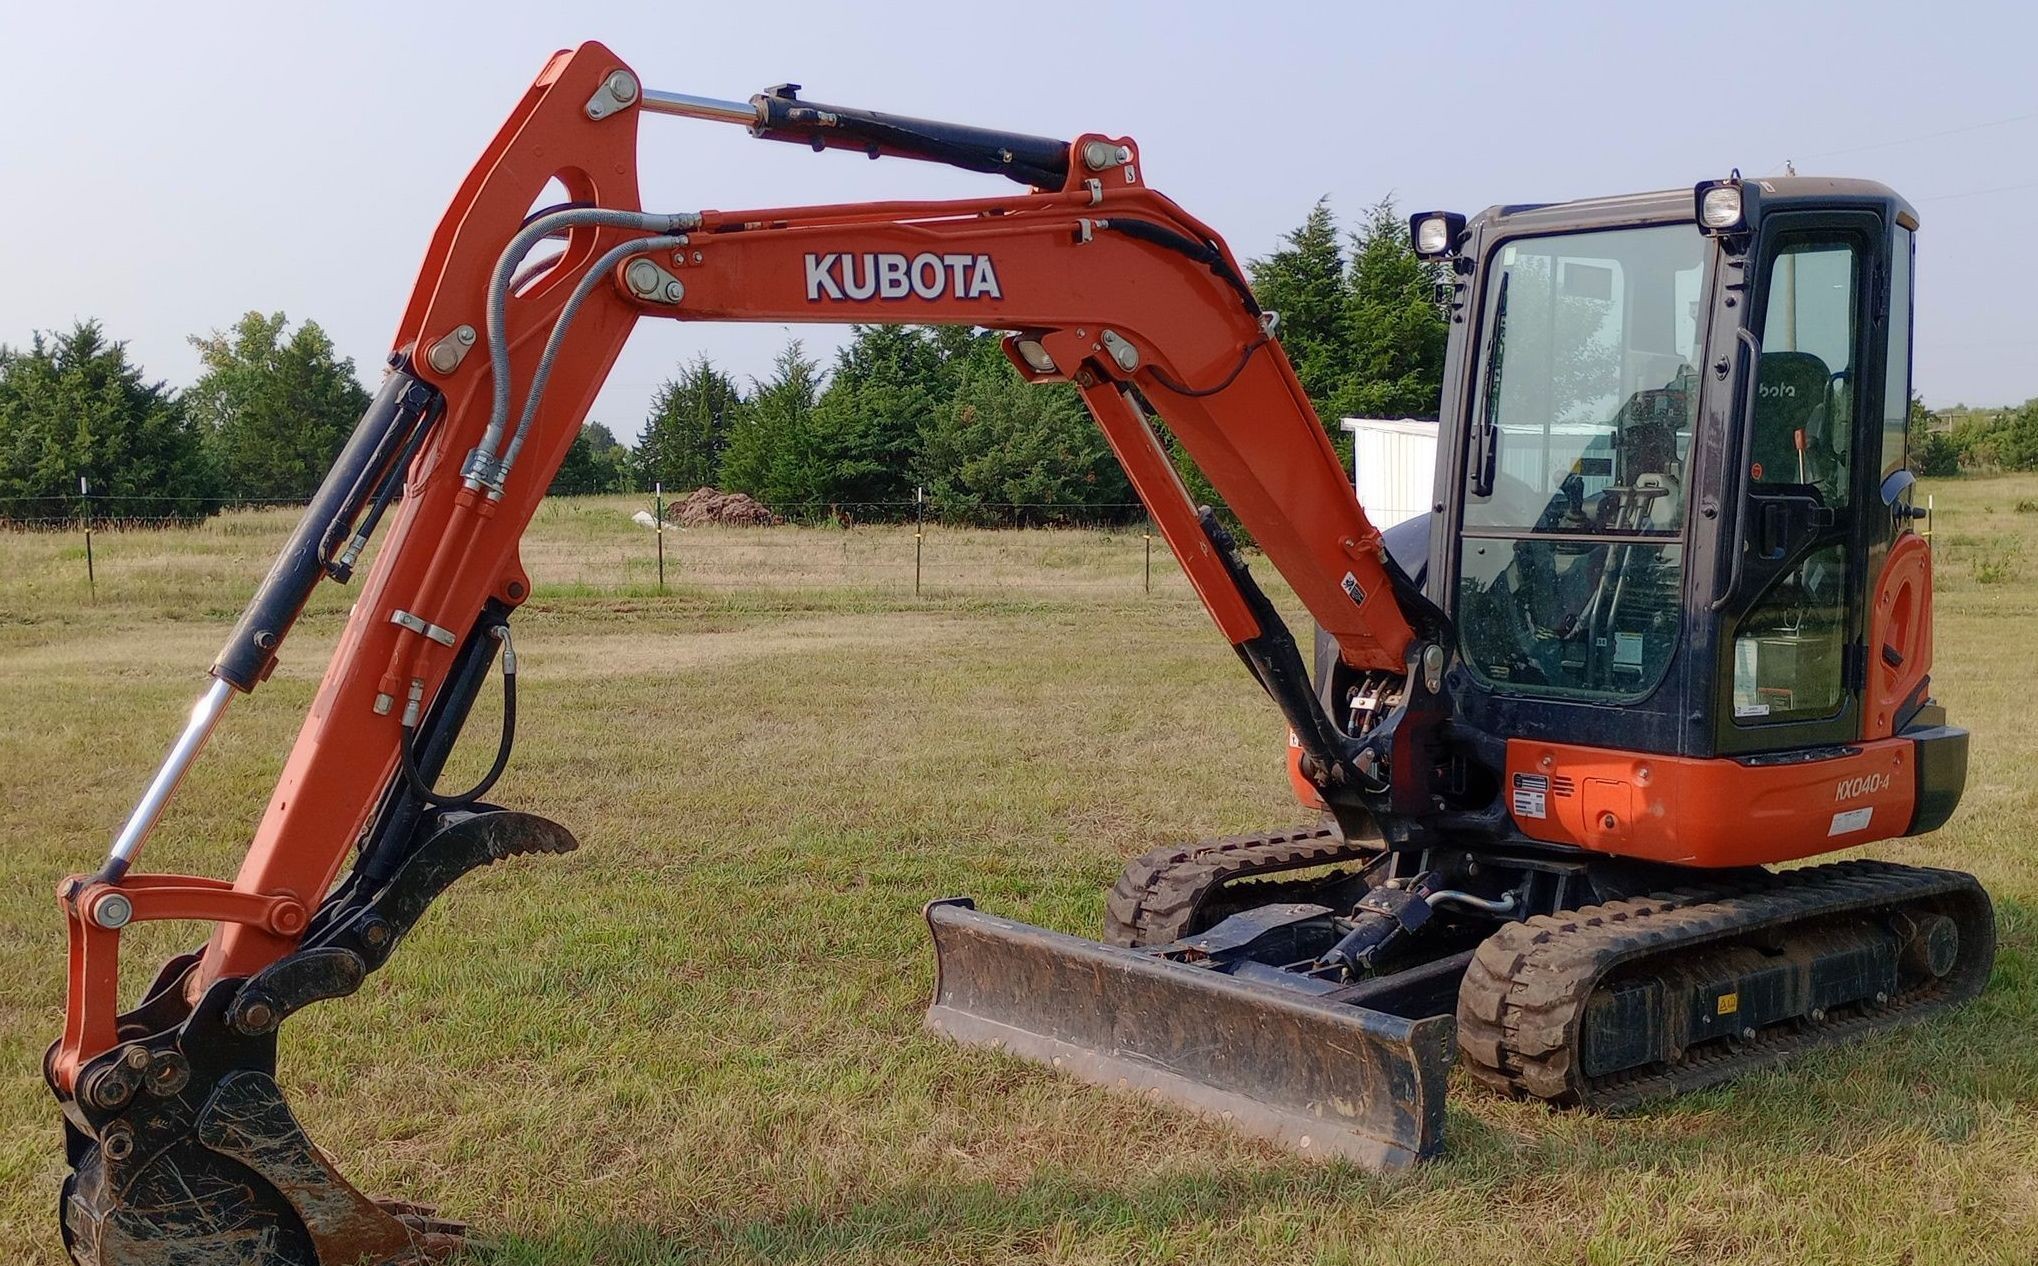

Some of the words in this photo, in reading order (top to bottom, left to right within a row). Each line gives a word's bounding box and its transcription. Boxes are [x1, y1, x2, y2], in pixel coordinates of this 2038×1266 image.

[803, 252, 1003, 301] KUBOTA
[1759, 382, 1795, 398] bota
[1835, 773, 1890, 801] KX040-4
